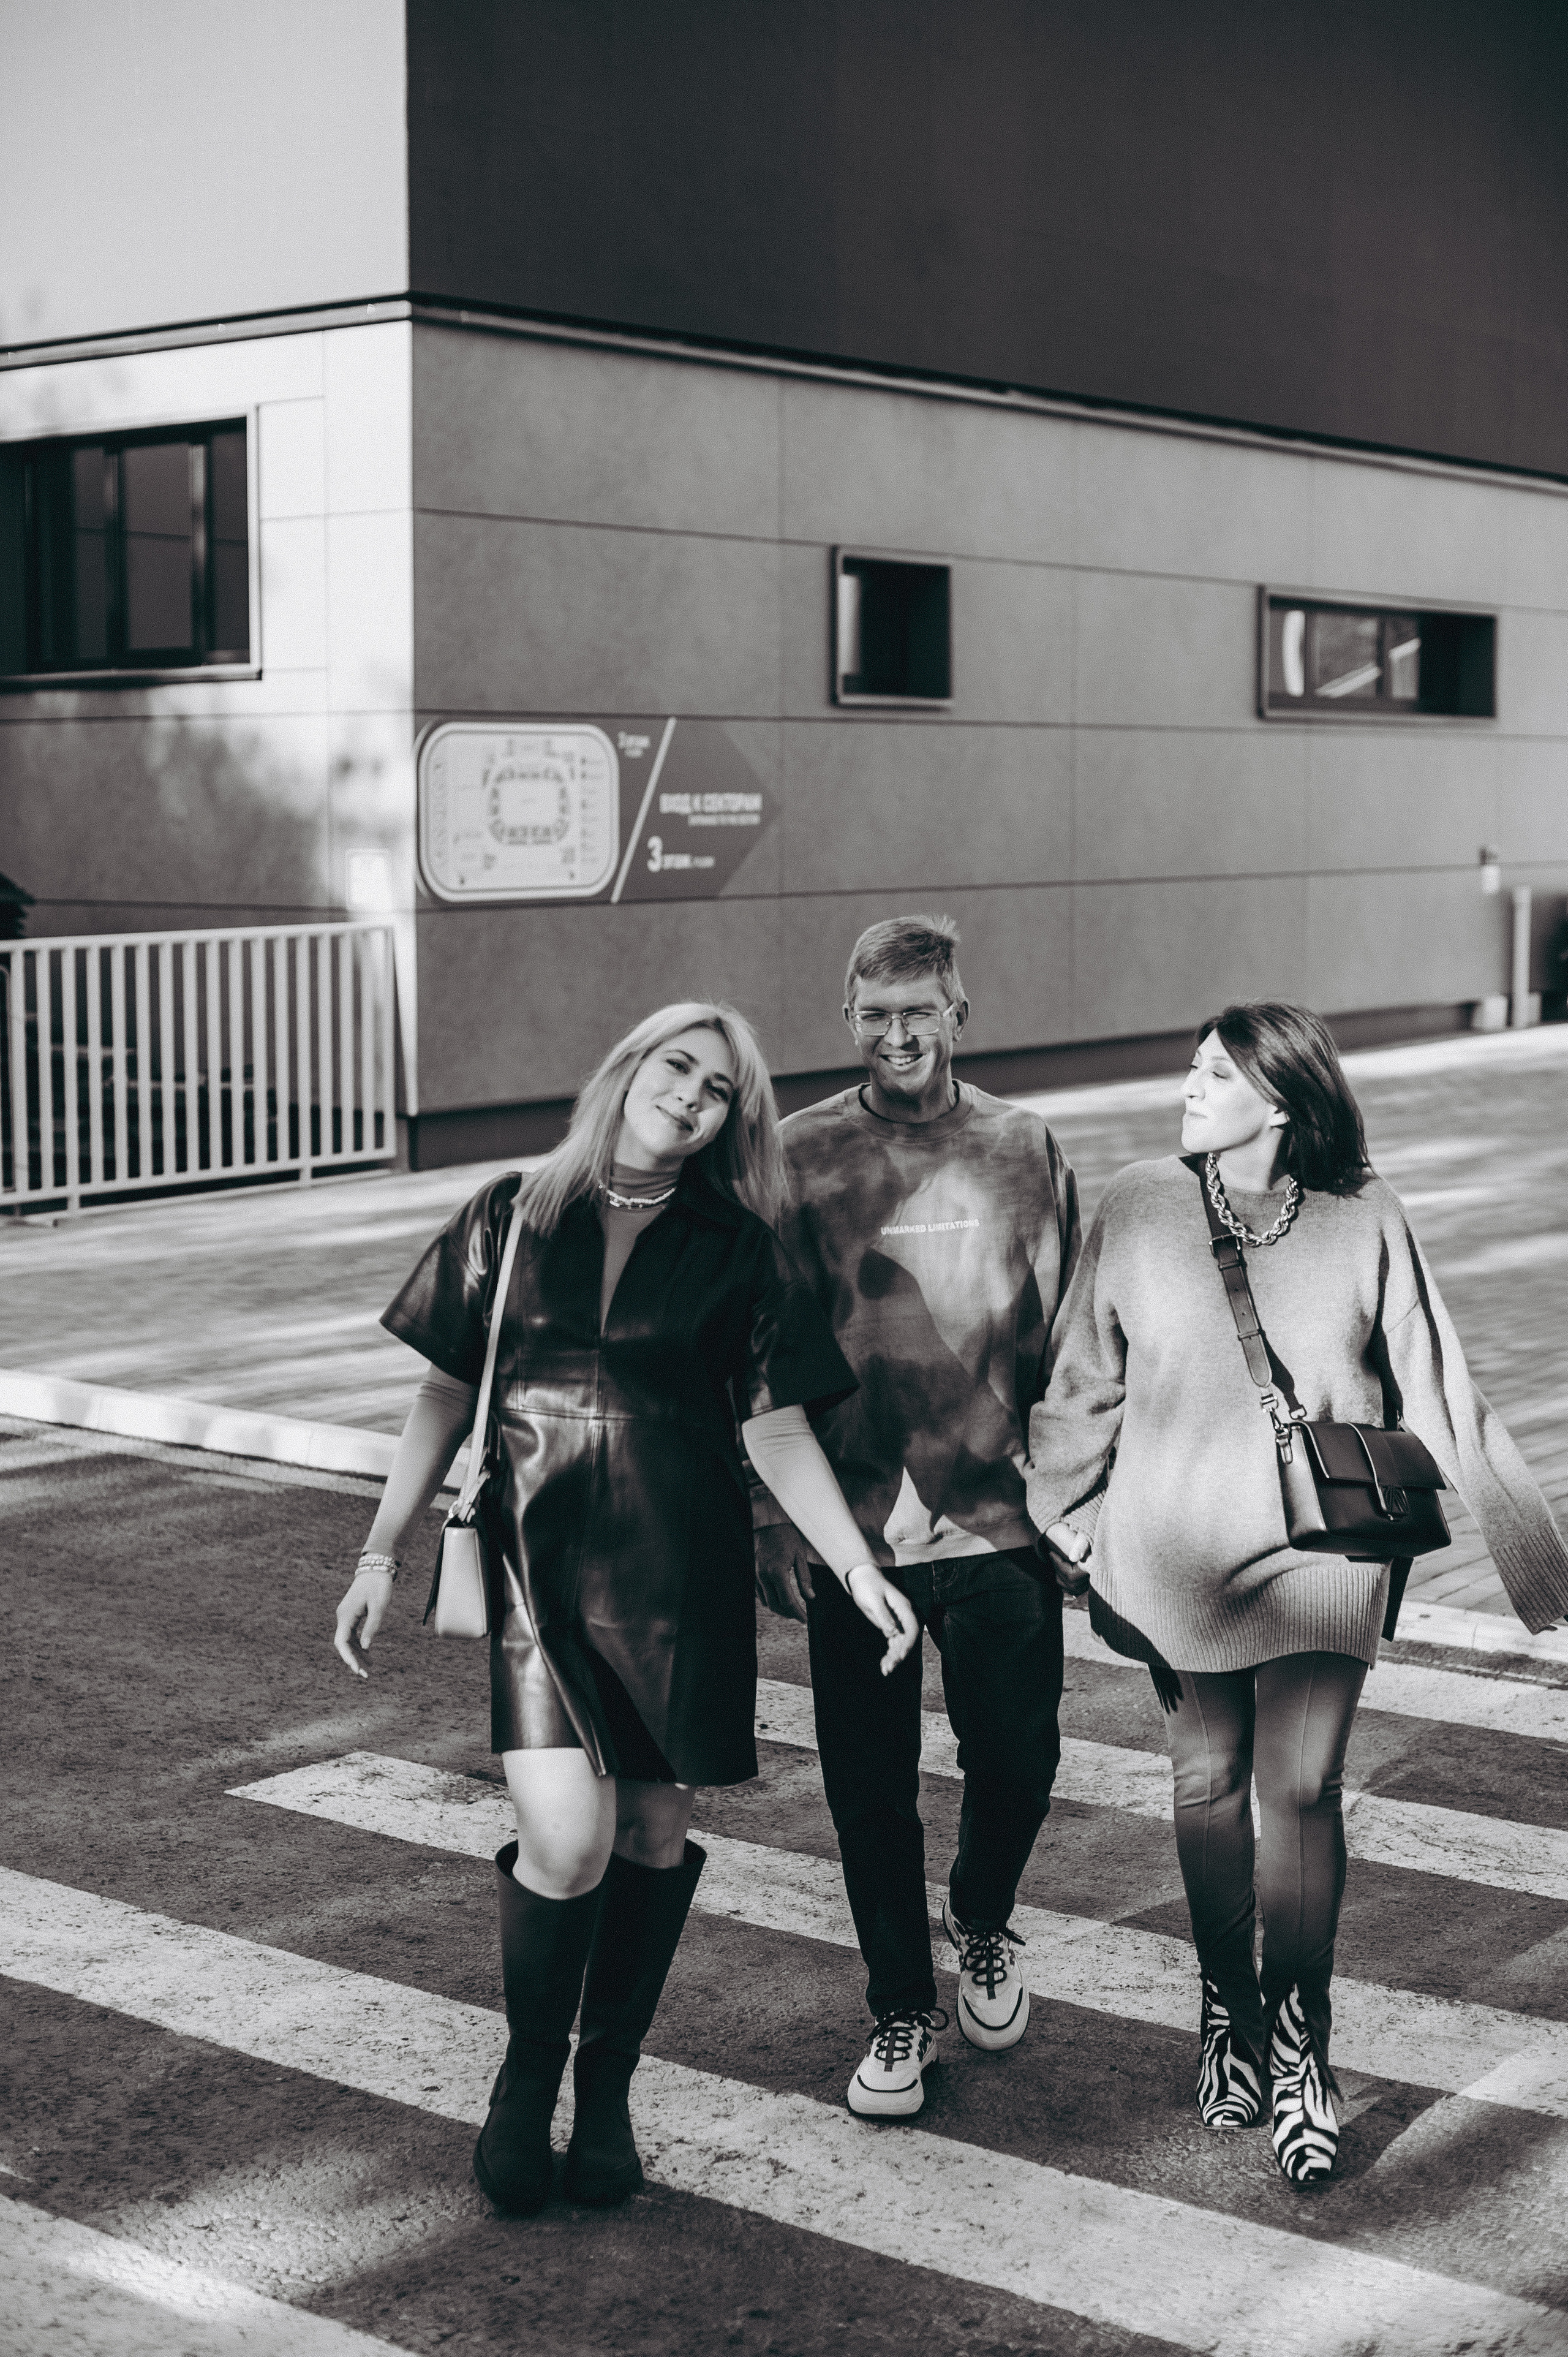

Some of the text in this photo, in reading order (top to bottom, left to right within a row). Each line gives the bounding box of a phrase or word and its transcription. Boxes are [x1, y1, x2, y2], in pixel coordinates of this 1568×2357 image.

[647, 836, 662, 872] 3
[881, 1219, 980, 1235] UNMARKED LIMITATIONS
